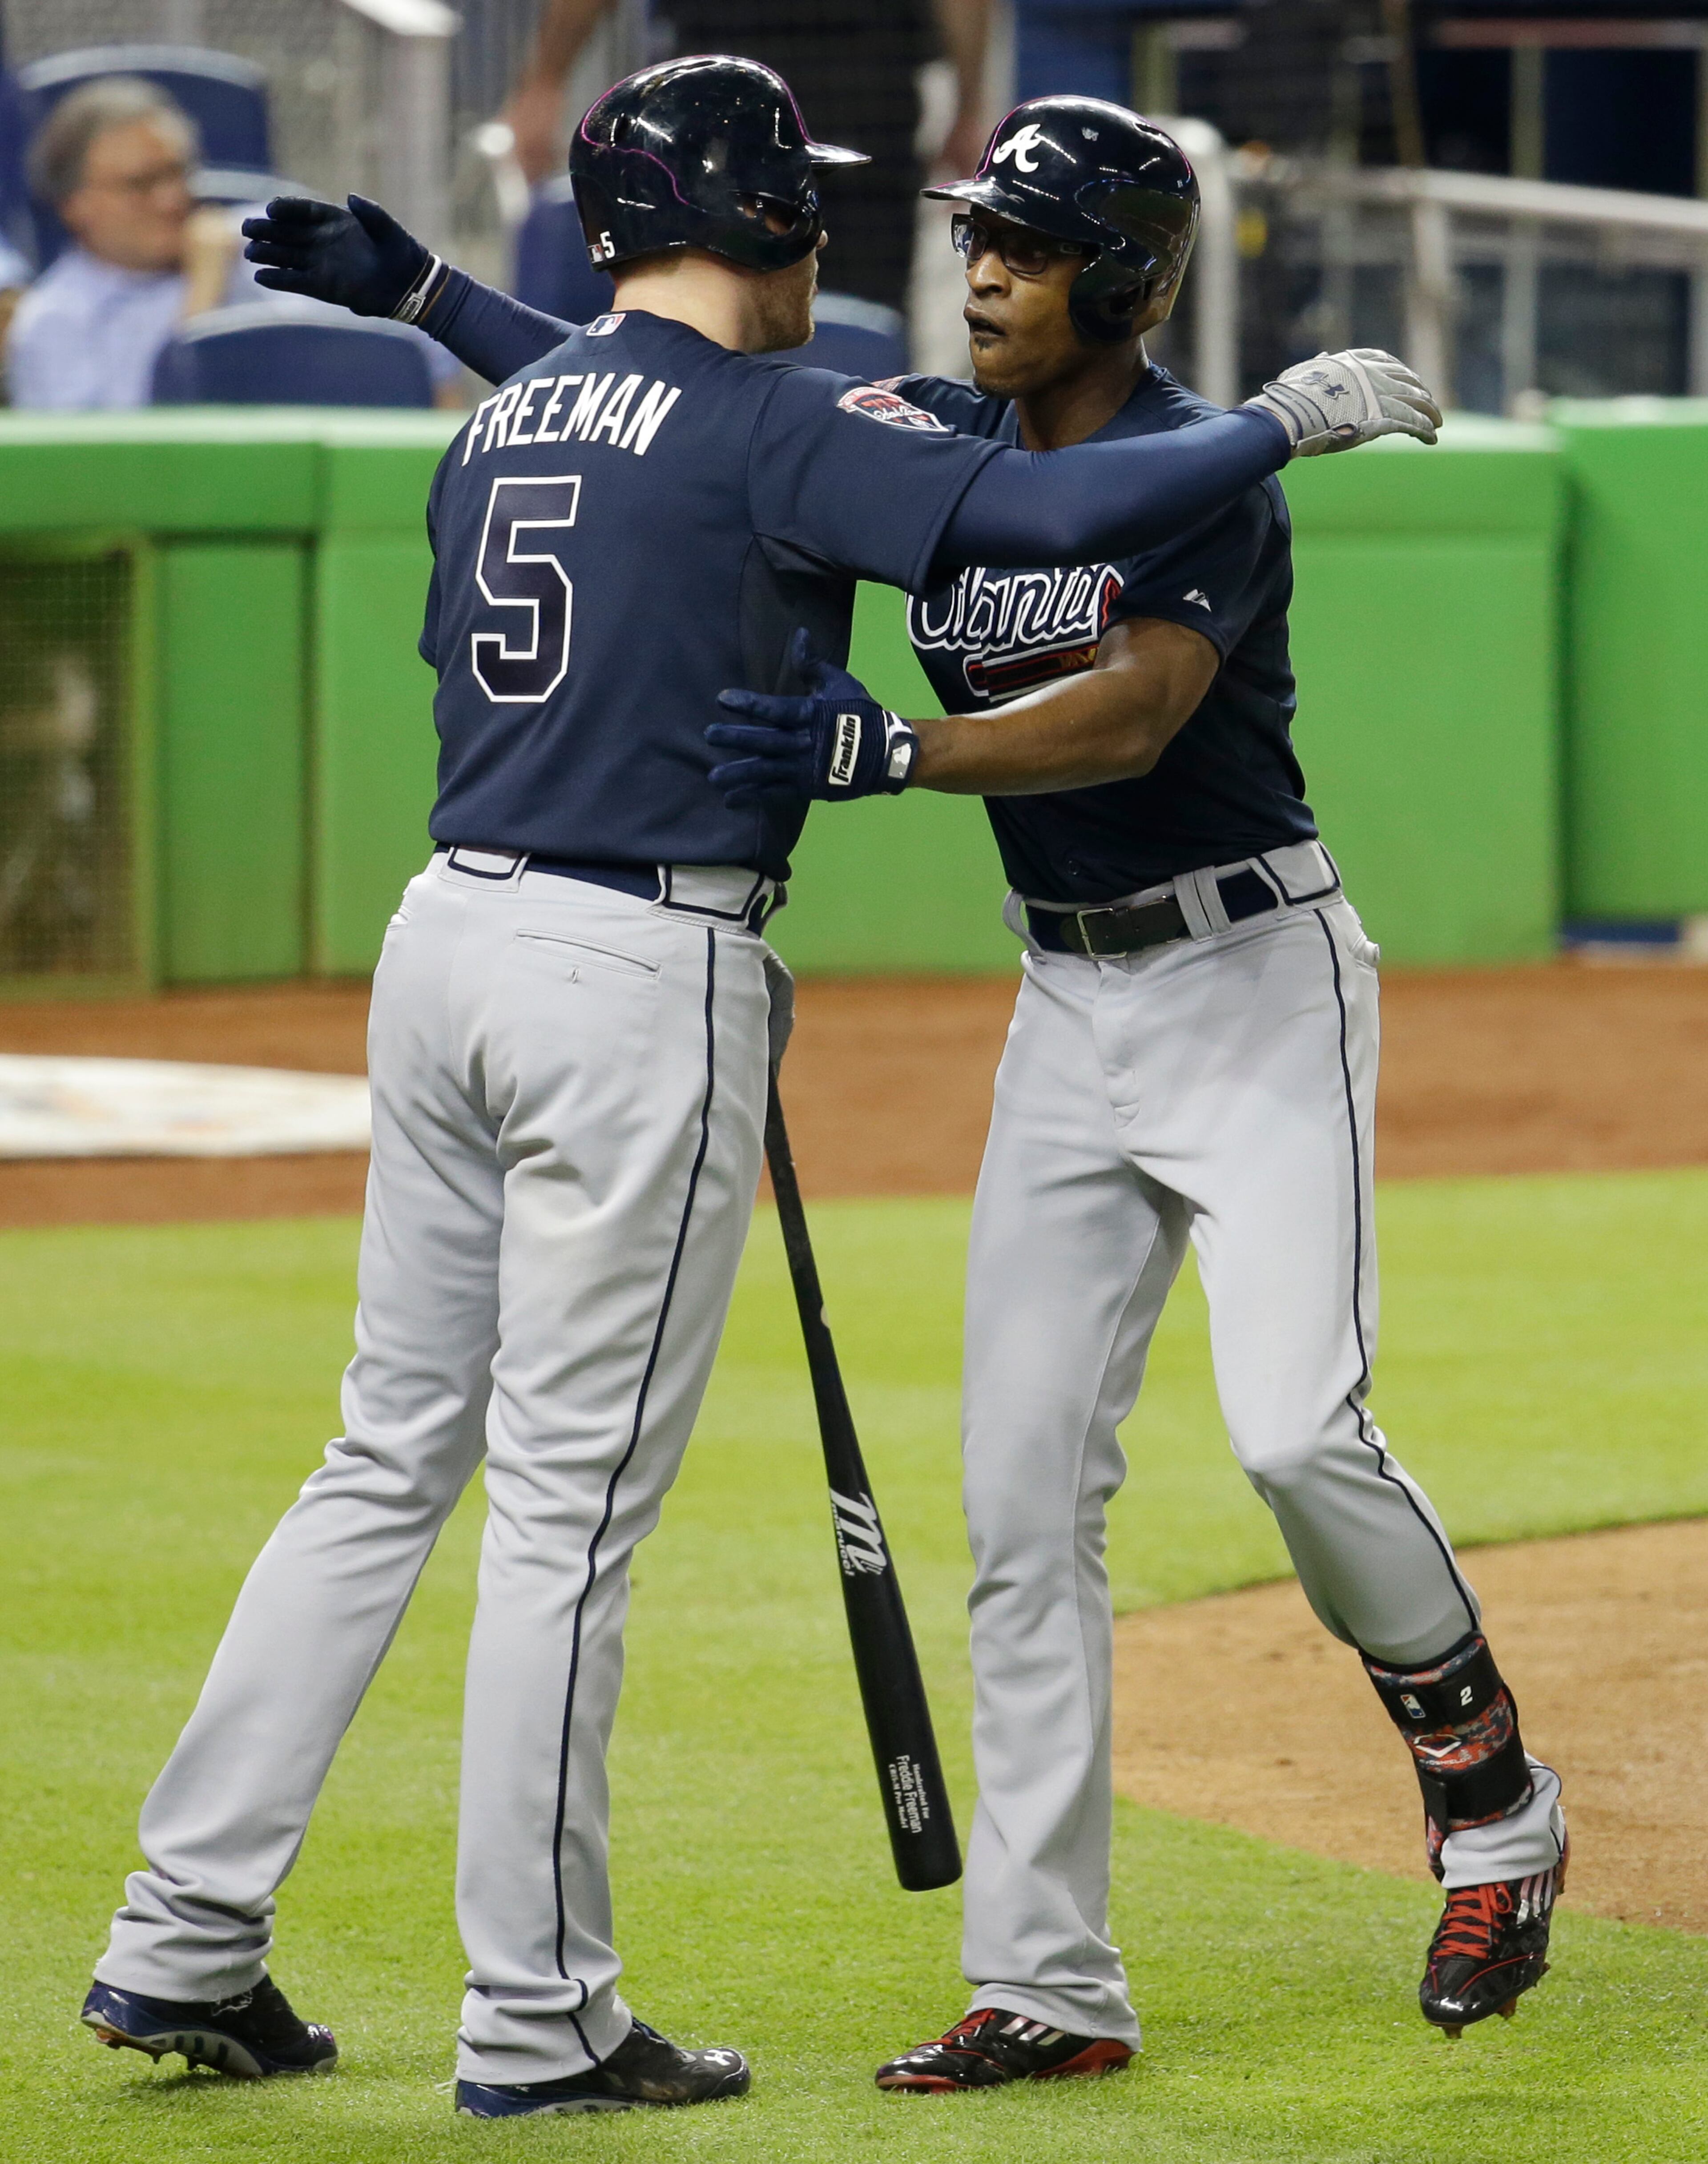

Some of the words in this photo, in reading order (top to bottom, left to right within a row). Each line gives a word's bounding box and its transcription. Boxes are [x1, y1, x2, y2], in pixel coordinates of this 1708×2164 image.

[600, 231, 616, 259] 5
[461, 372, 682, 467] FREEMAN
[471, 475, 581, 702] 5
[831, 716, 856, 782] Franklin
[1460, 1686, 1473, 1706] 2
[896, 1754, 915, 1790] Freddie
[904, 1791, 922, 1833] Freeman
